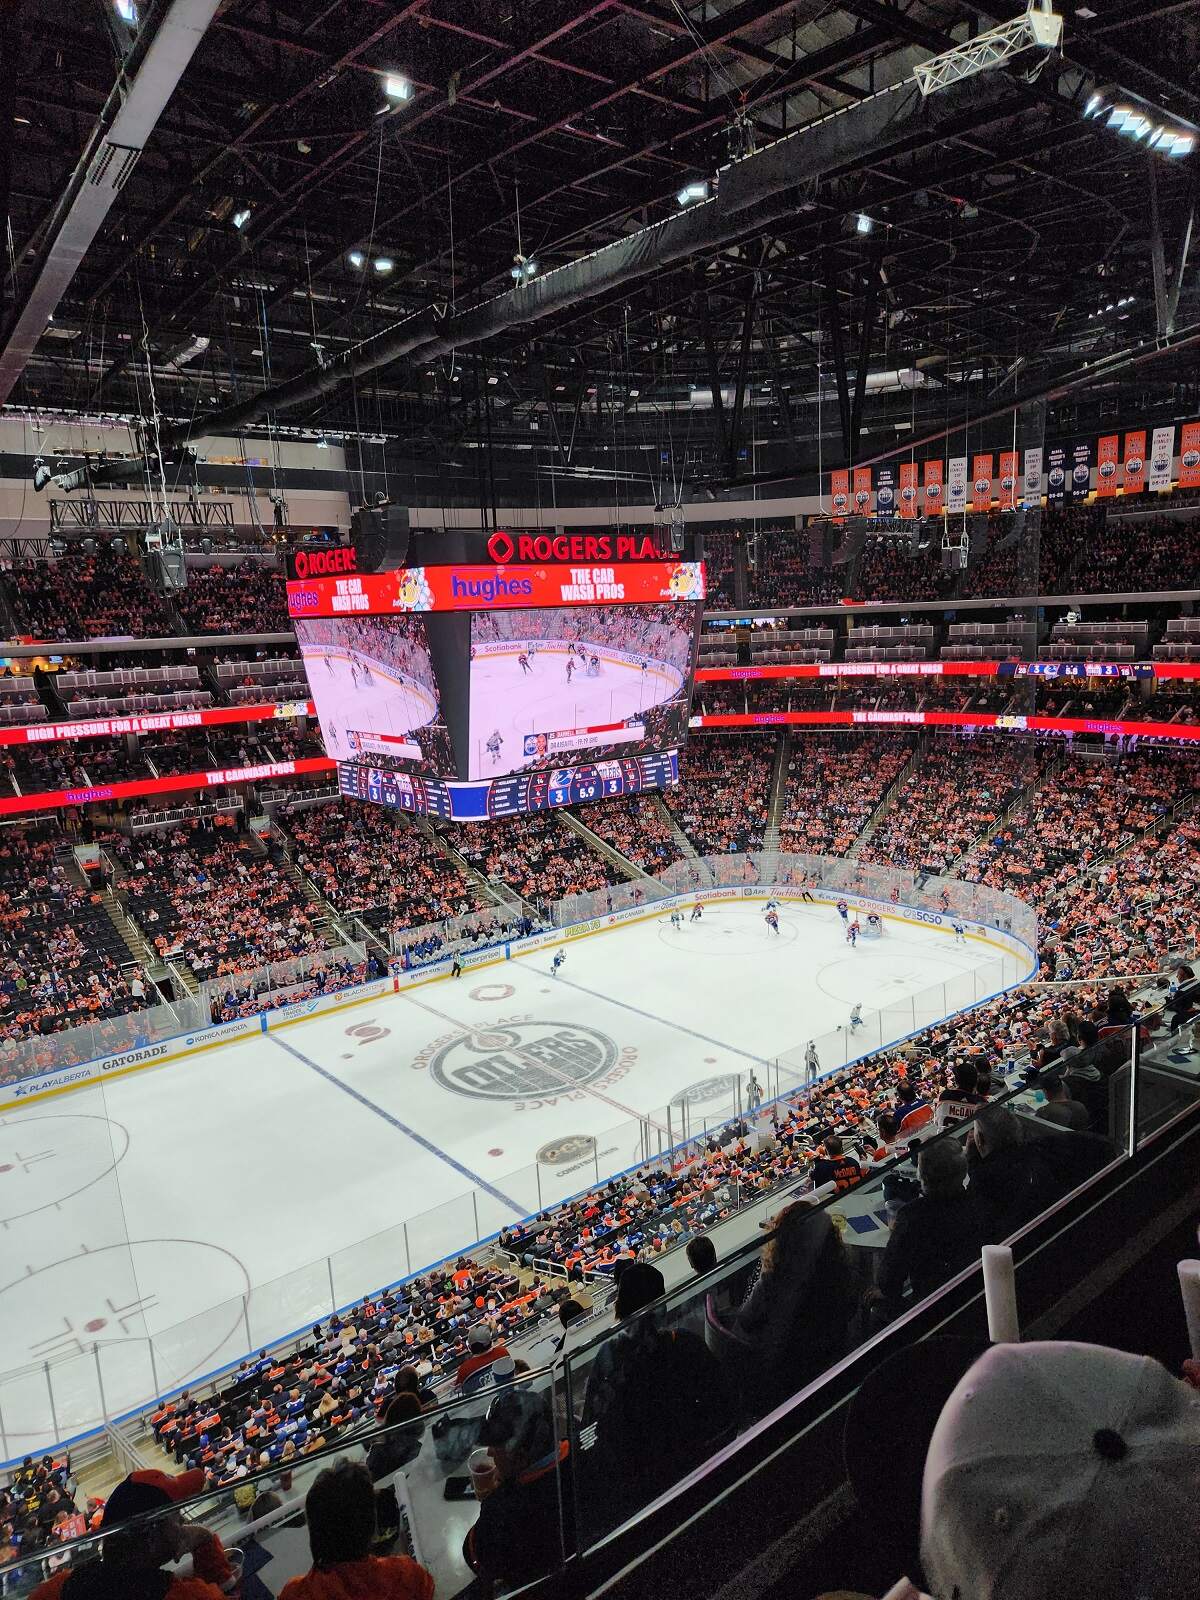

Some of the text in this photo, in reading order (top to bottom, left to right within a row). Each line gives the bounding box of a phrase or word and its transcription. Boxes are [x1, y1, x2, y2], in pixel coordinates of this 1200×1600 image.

[518, 535, 612, 560] ROGERS
[570, 568, 615, 584] THE CAR
[335, 578, 363, 595] THE CAR
[451, 574, 533, 602] hughes
[560, 583, 625, 601] WASH PROS
[332, 594, 370, 611] WASH PROS
[484, 643, 522, 653] Scotiabank
[1033, 665, 1040, 674] 3
[1105, 665, 1112, 674] 3
[852, 711, 867, 722] THE
[26, 713, 202, 741] HIGH PRESSURE FOR A GREAT WASH
[206, 761, 295, 784] THE CARWASH PROS
[372, 787, 378, 800] 3
[609, 780, 617, 793] 3
[66, 789, 113, 803] hughes
[404, 794, 411, 808] 3
[555, 789, 563, 803] 3
[694, 889, 737, 901] Scotiabank
[625, 909, 645, 919] CANADA
[866, 901, 896, 913] ROGERS
[564, 923, 590, 937] PIZZA
[473, 1014, 534, 1028] PLACE
[194, 1023, 248, 1043] KONICA MINOLTA
[102, 1045, 168, 1070] GATORADE
[29, 1069, 91, 1092] PLAYALBERTA
